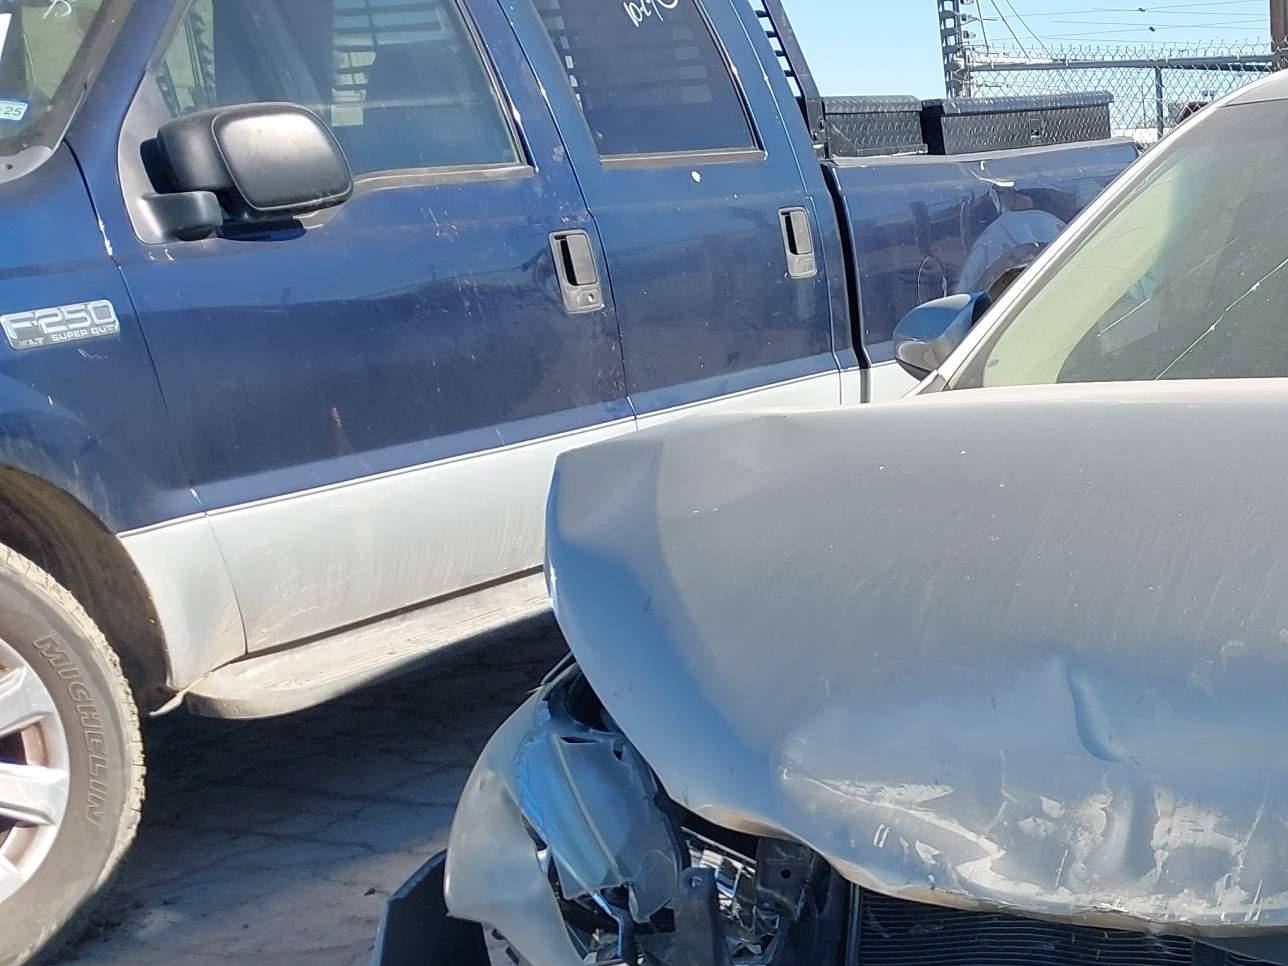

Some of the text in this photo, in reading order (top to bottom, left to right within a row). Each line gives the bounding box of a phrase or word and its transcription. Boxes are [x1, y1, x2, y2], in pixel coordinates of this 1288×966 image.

[4, 106, 23, 116] 25
[50, 331, 88, 342] SUPER
[90, 324, 119, 336] DUTY
[32, 635, 108, 831] MICHELIN
